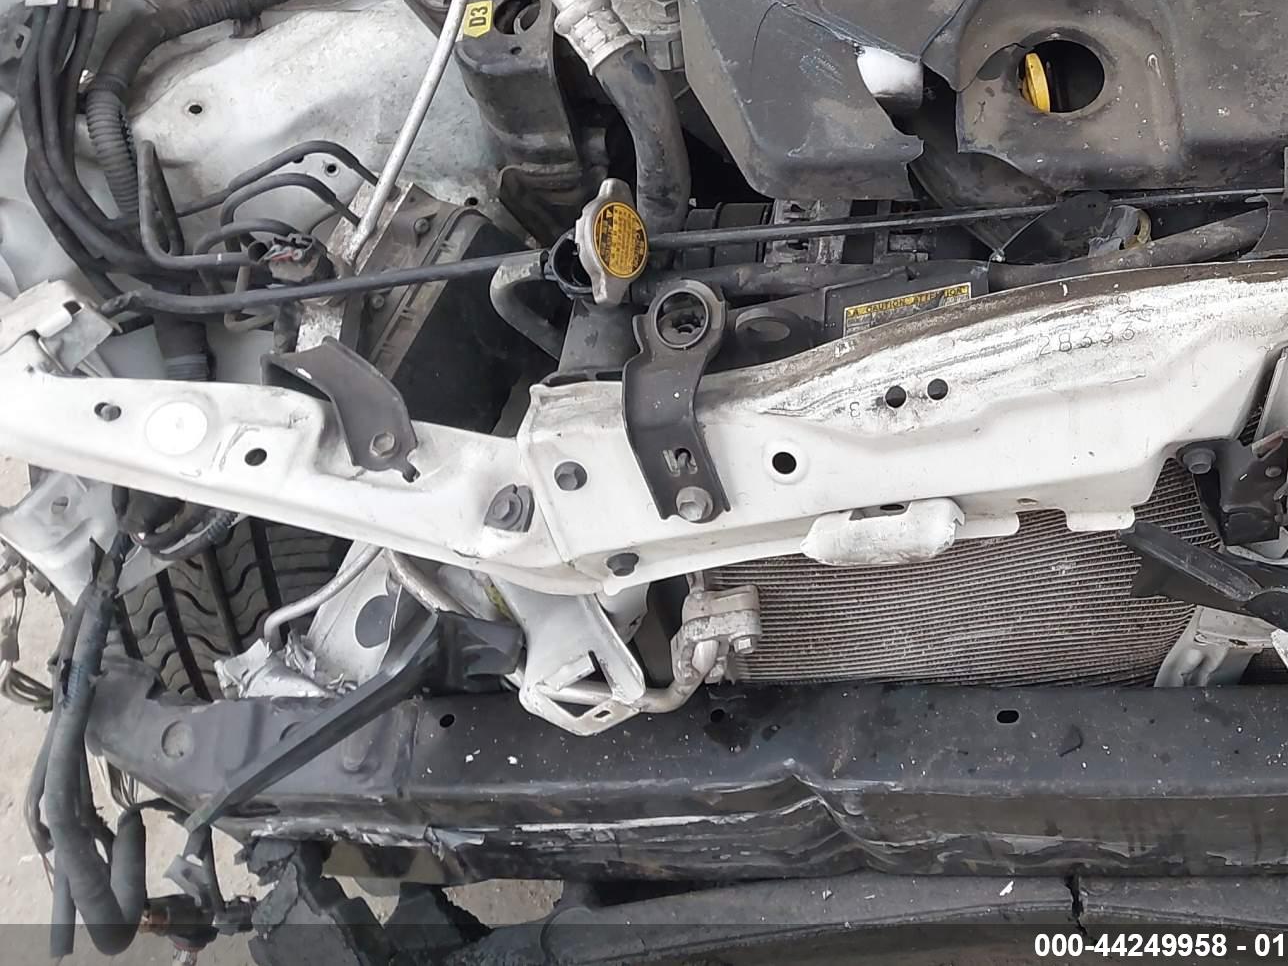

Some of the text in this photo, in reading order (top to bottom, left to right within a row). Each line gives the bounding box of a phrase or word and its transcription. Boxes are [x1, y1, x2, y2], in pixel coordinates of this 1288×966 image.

[469, 6, 489, 28] D3
[866, 299, 907, 313] CAUTION
[913, 287, 965, 305] ATTEION
